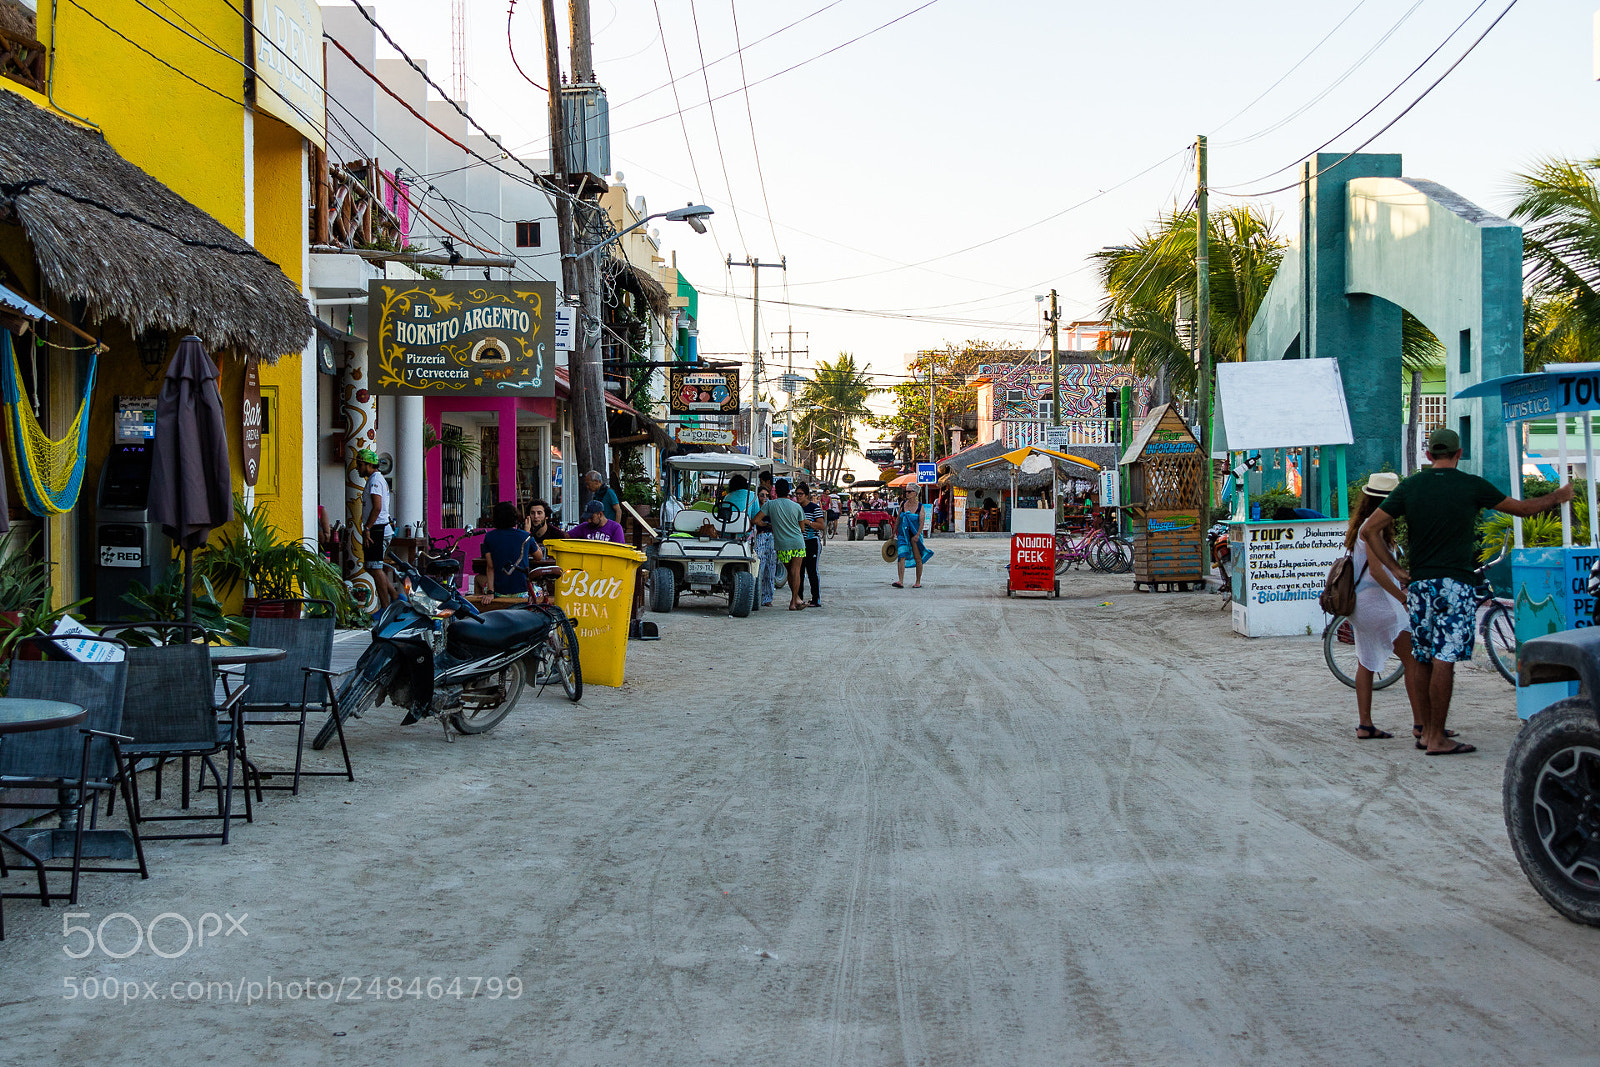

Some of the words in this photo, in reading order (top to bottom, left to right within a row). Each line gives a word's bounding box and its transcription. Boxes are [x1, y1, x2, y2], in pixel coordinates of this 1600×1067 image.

[258, 0, 325, 109] ARENA
[414, 304, 431, 318] EL
[462, 306, 530, 334] ARGENTO
[406, 352, 446, 365] Pizzería
[407, 370, 413, 380] y
[416, 366, 470, 379] Cervecería
[243, 399, 261, 427] Bar
[246, 430, 259, 440] ARENA
[1155, 429, 1184, 441] Tour
[1146, 442, 1196, 455] INFORMATION
[1016, 536, 1052, 549] NOJOCH
[117, 552, 141, 561] RED
[1017, 550, 1045, 563] PEEK
[1249, 561, 1257, 569] 3
[1258, 560, 1278, 569] Islas
[561, 567, 623, 599] Bar
[564, 601, 609, 619] ARENA
